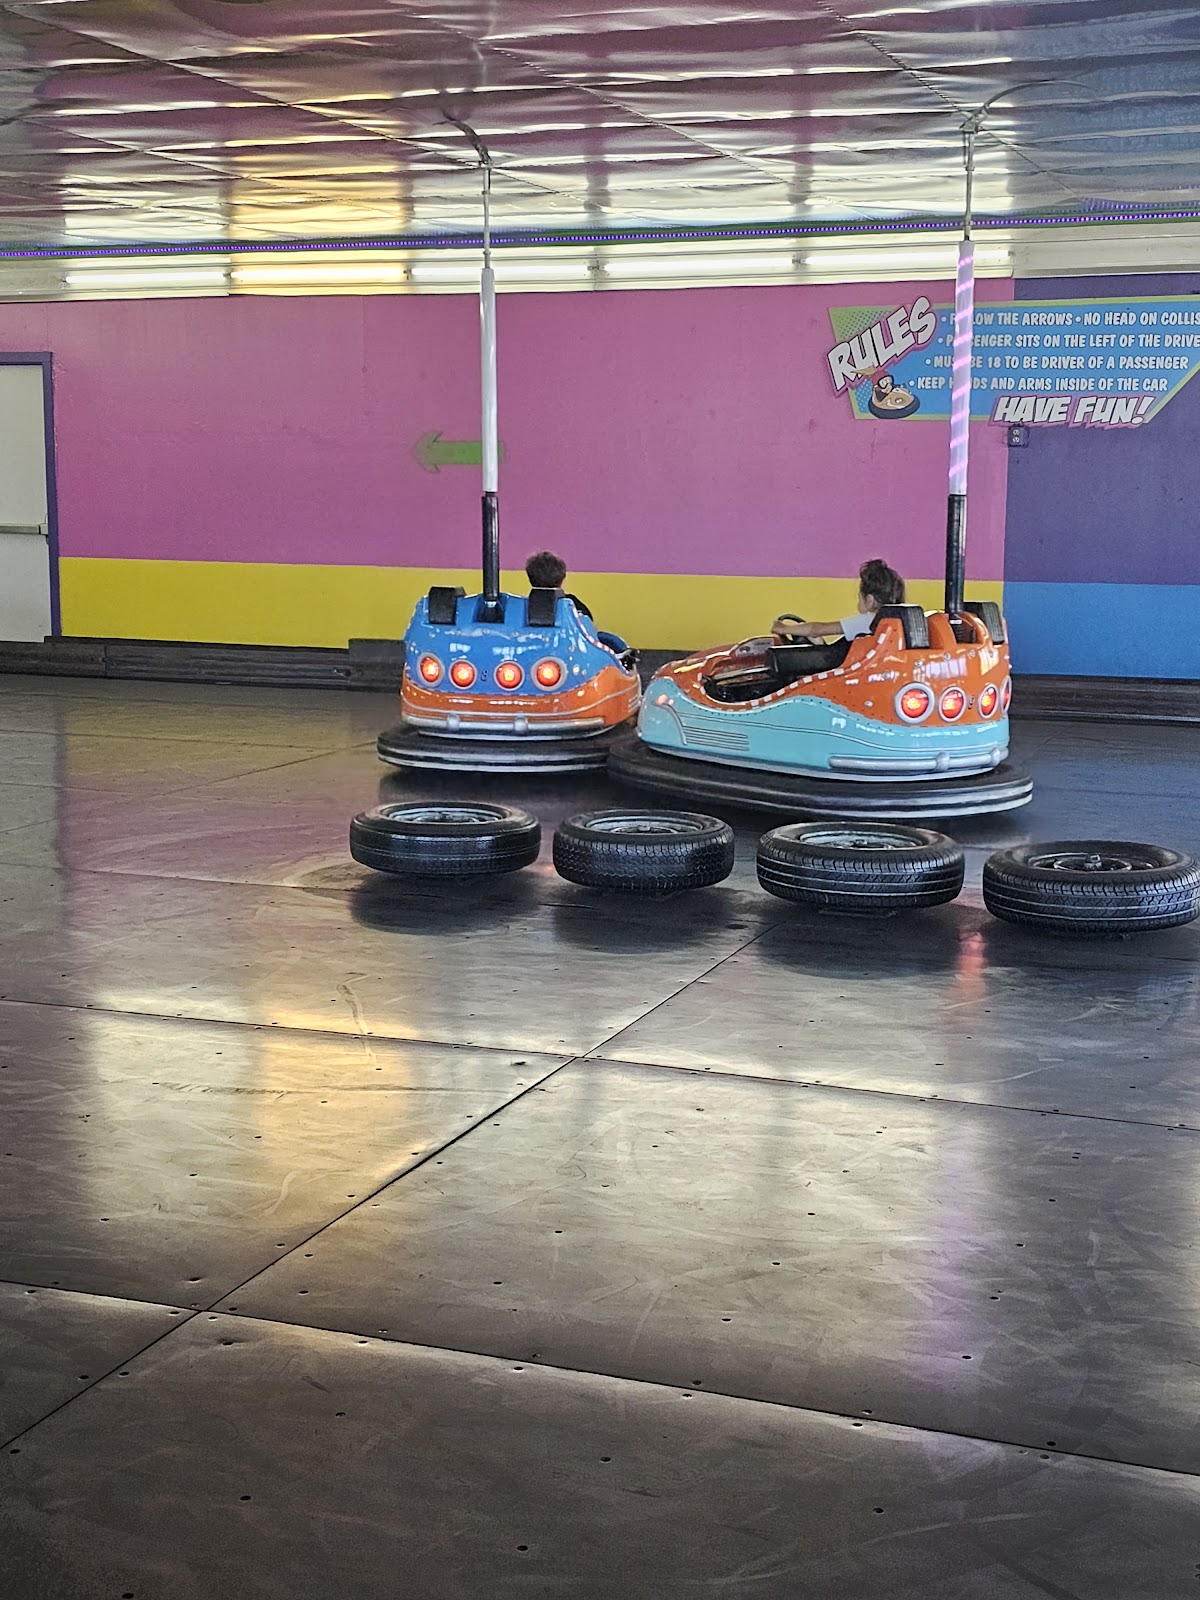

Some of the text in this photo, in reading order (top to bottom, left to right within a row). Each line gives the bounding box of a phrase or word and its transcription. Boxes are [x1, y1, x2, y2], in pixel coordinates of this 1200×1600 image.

[997, 312, 1019, 326] THE
[1021, 312, 1073, 326] ARROWS
[1083, 312, 1100, 326] NO
[1104, 312, 1136, 326] HEAD
[1139, 312, 1157, 326] ON
[827, 296, 936, 391] RULES
[1015, 334, 1040, 347] SITS
[1043, 334, 1060, 347] ON
[1064, 334, 1086, 347] THE
[1089, 334, 1117, 347] LEFT
[1119, 334, 1135, 347] OF
[1138, 333, 1161, 347] THE
[1164, 333, 1200, 348] DRIVE
[987, 356, 1001, 368] 18
[1005, 356, 1019, 369] TO
[1022, 356, 1038, 369] BE
[1041, 356, 1085, 369] DRIVER
[1088, 356, 1104, 369] OF
[1106, 356, 1115, 369] A
[1119, 356, 1189, 369] PASSENGER
[917, 377, 945, 389] KEEP
[990, 377, 1015, 390] AND
[1018, 378, 1052, 391] ARMS
[1055, 378, 1095, 391] INSIDE
[1098, 378, 1114, 391] OF
[1117, 378, 1139, 391] THE
[1142, 378, 1168, 391] CAR
[993, 396, 1155, 425] HAVE FUN!
